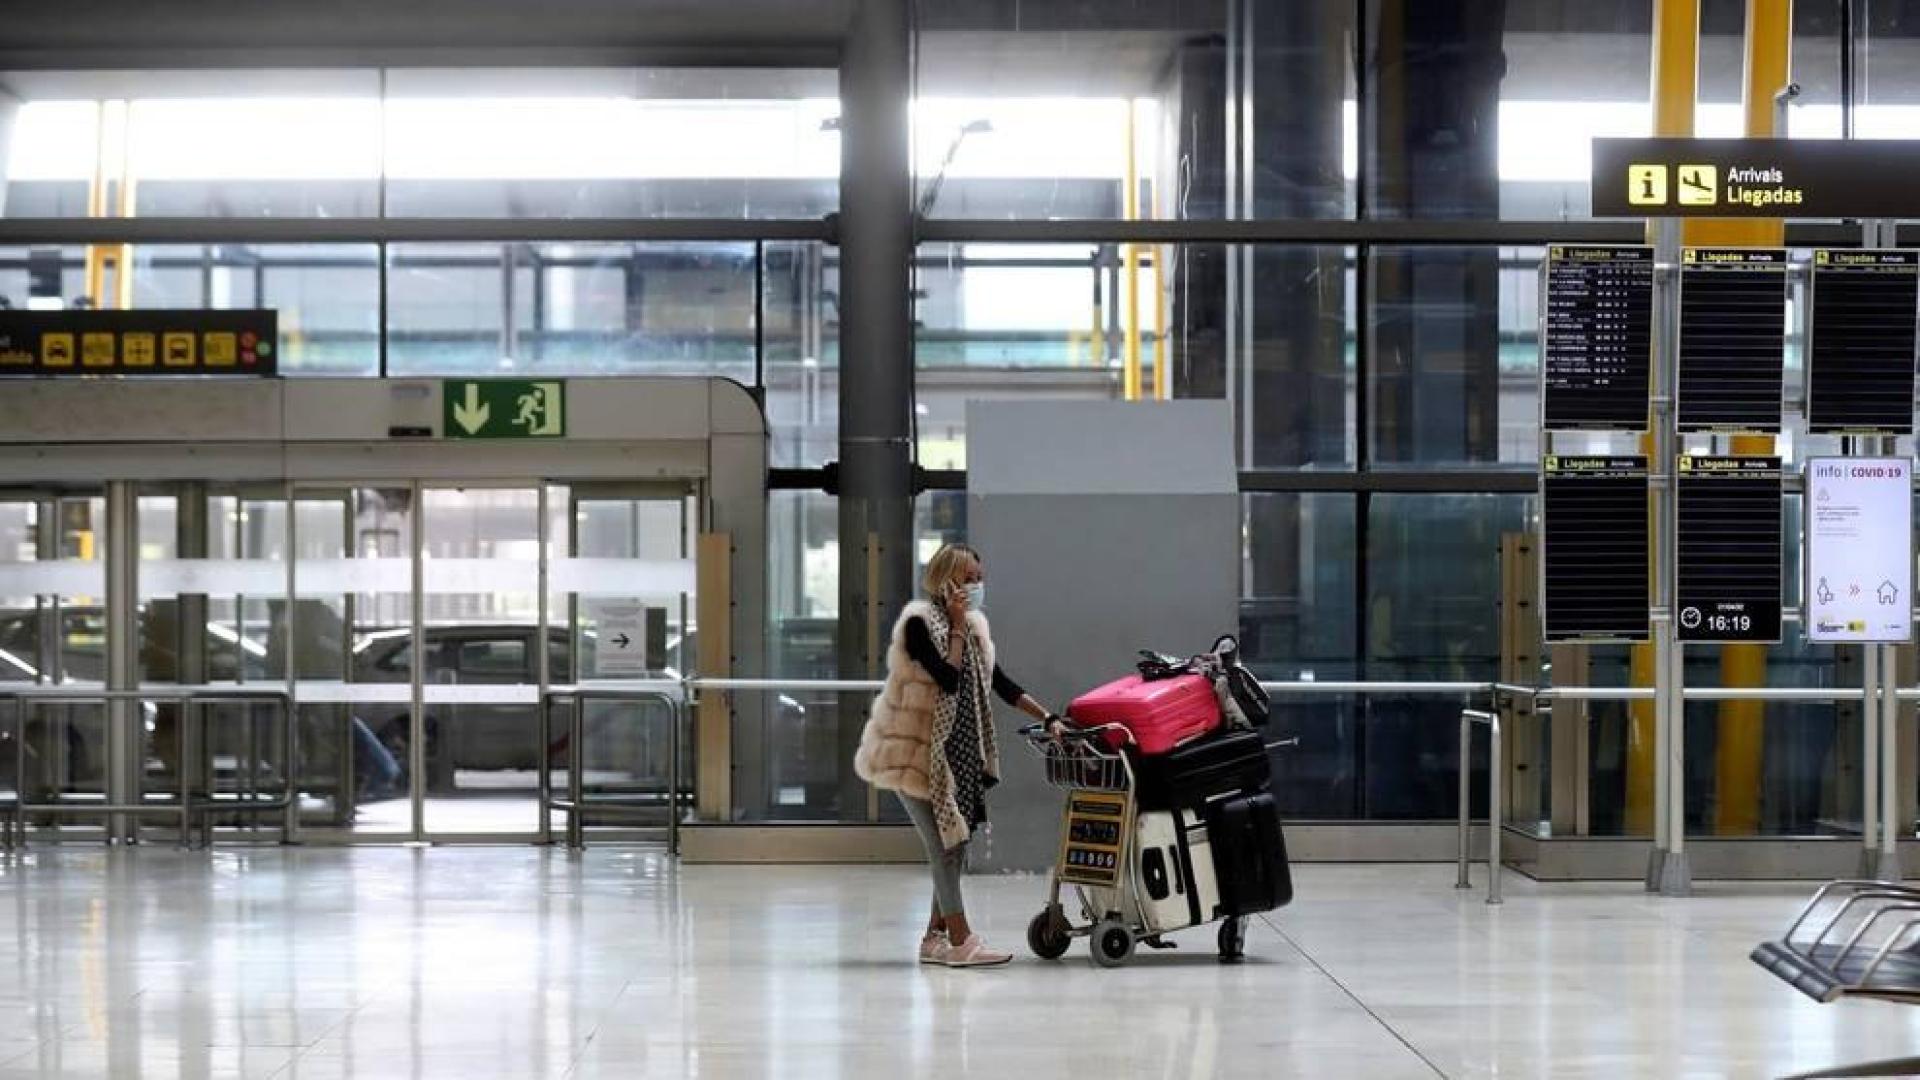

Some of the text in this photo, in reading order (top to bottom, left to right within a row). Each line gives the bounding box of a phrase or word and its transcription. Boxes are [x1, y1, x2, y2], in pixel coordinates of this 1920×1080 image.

[1727, 166, 1784, 184] Arrivals
[1727, 185, 1803, 206] Llegadas
[1816, 465, 1841, 478] info
[1707, 615, 1750, 631] 16:19
